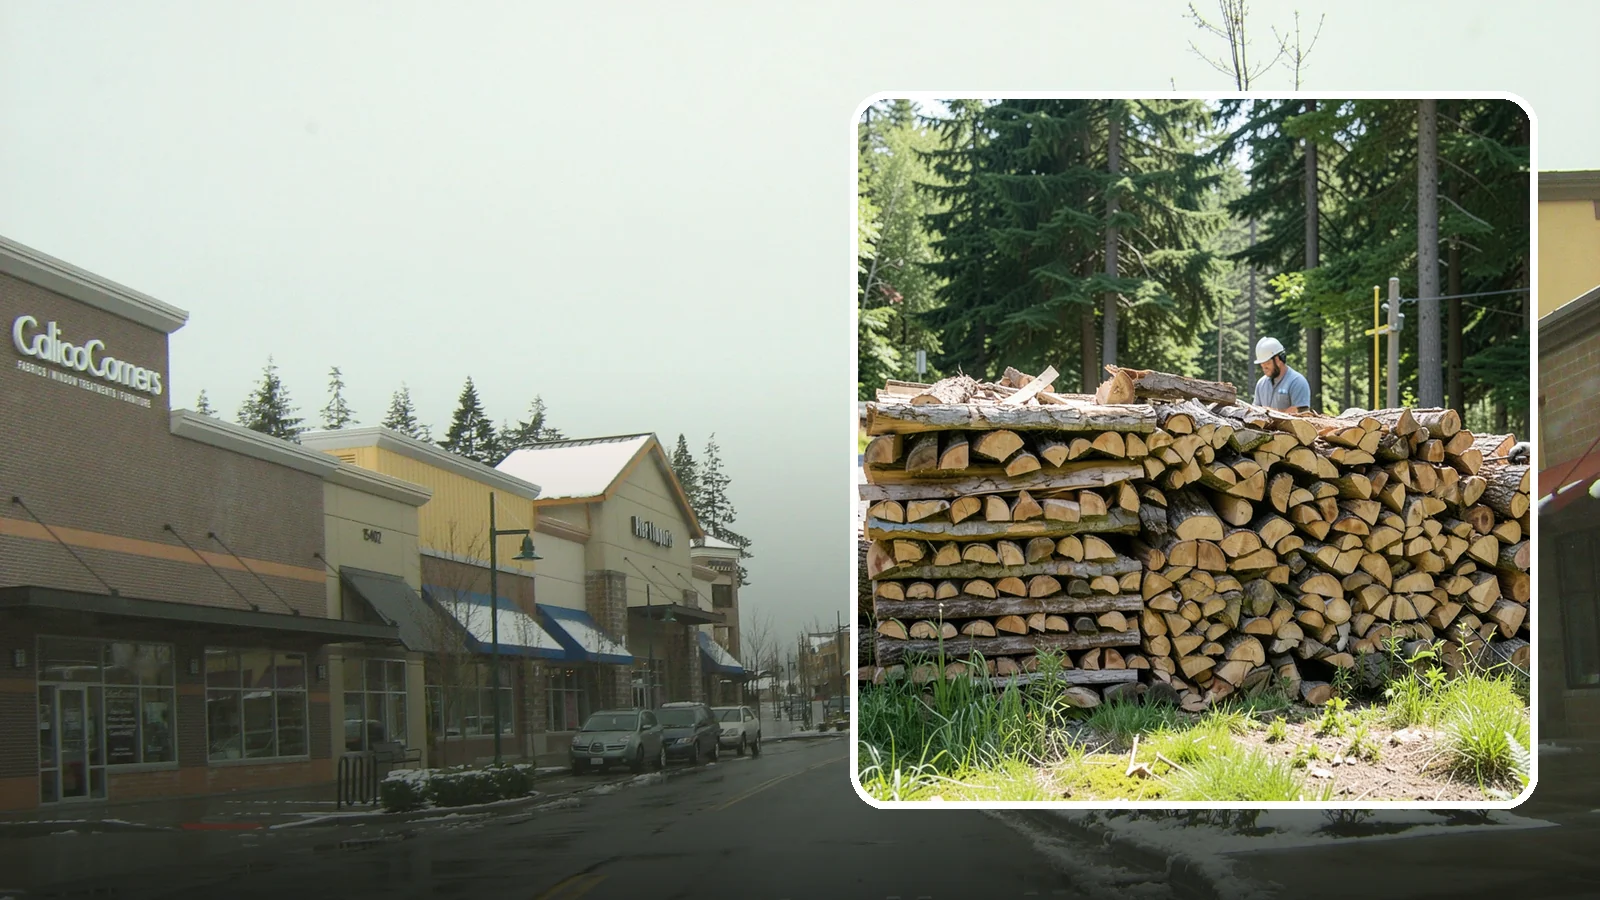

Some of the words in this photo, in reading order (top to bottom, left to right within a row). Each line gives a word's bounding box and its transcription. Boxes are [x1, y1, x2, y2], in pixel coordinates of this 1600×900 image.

[16, 360, 47, 378] FABRICS
[51, 370, 78, 387] WINDOW
[78, 378, 117, 399] TREATMENTS
[120, 391, 151, 409] FURNITURE
